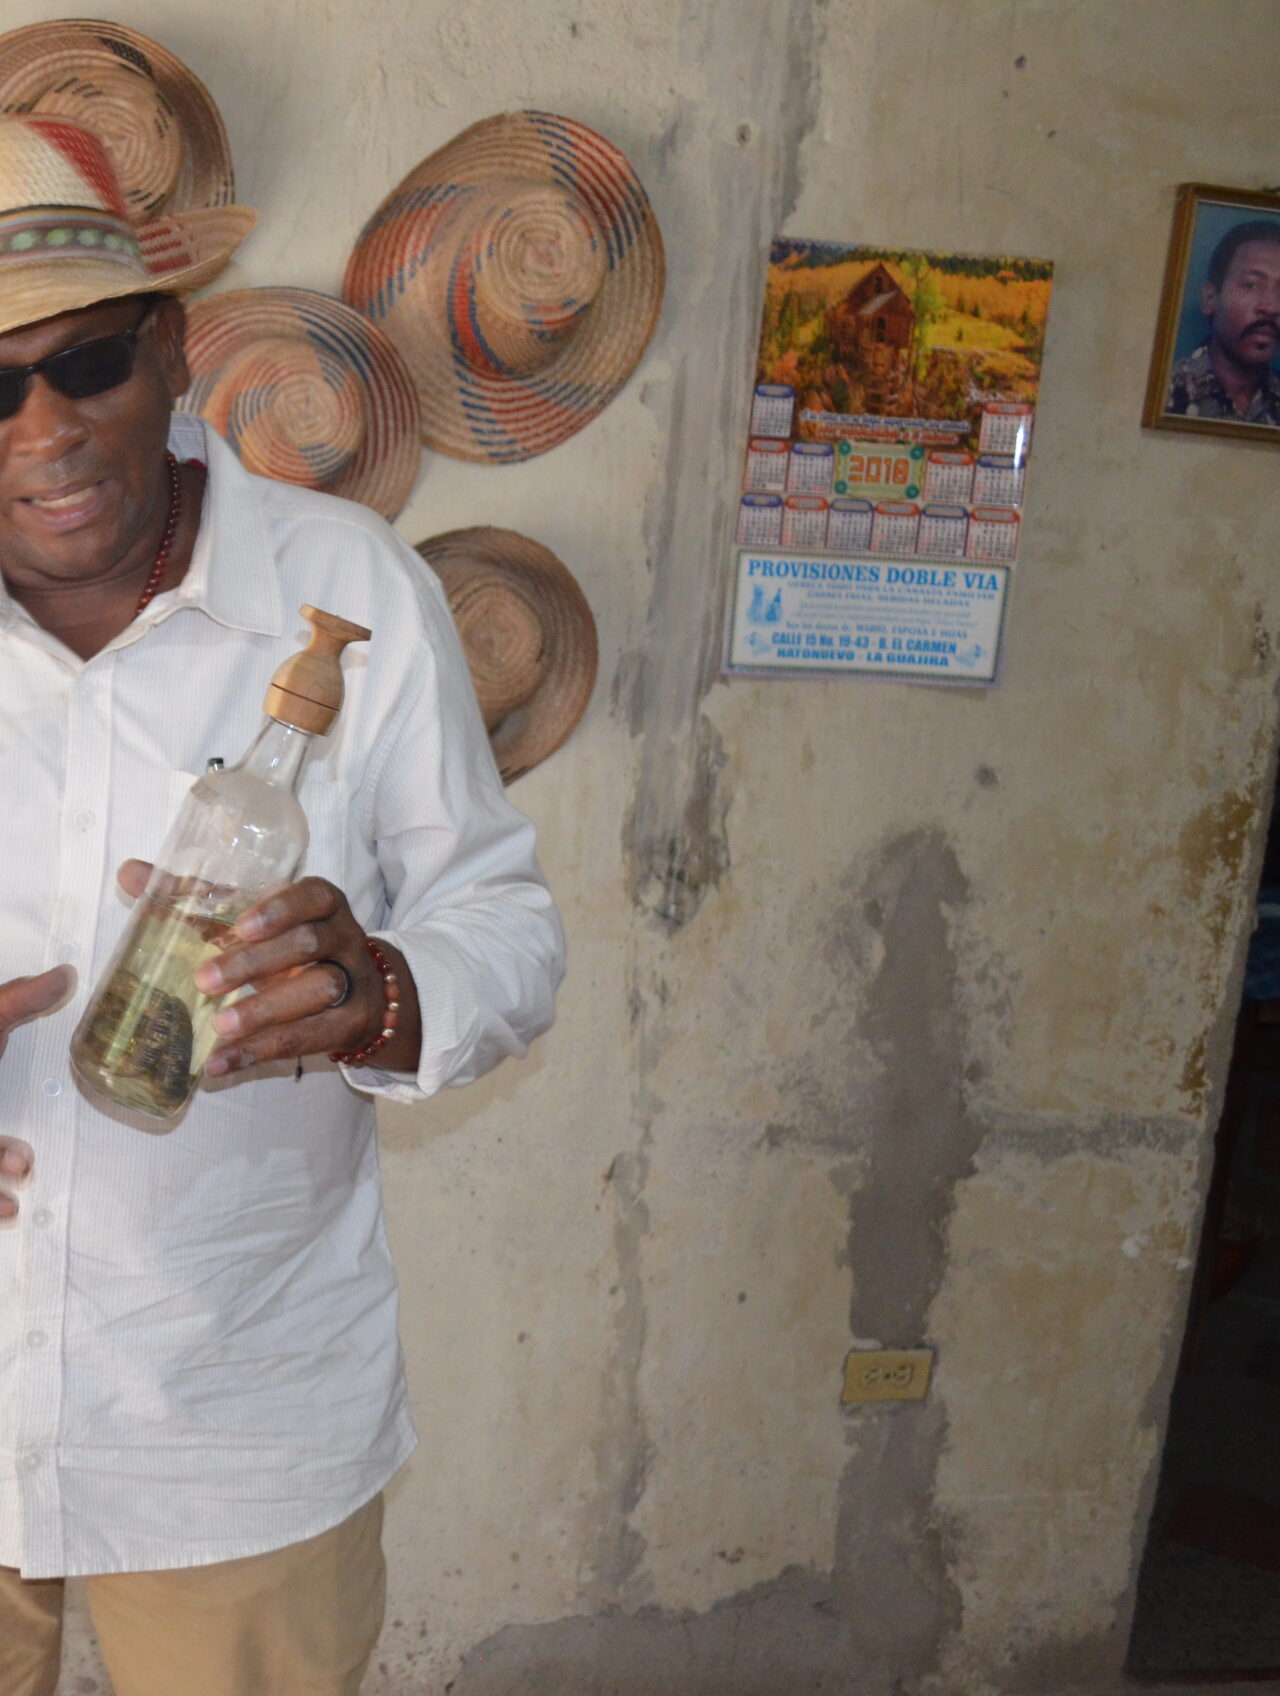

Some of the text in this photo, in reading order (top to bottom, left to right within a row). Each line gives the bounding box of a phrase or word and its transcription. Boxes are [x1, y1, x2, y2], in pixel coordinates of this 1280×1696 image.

[848, 455, 910, 485] 2018
[747, 558, 999, 591] PROVISIONES DOBLE VIA
[772, 631, 802, 646] CALLE
[805, 633, 817, 646] 15
[839, 635, 870, 649] 19-43
[892, 638, 905, 651] EL
[907, 639, 958, 655] CARMEN
[777, 647, 856, 662] HATONUEVO
[866, 651, 883, 663] LA
[886, 653, 950, 667] GUAJIRA
